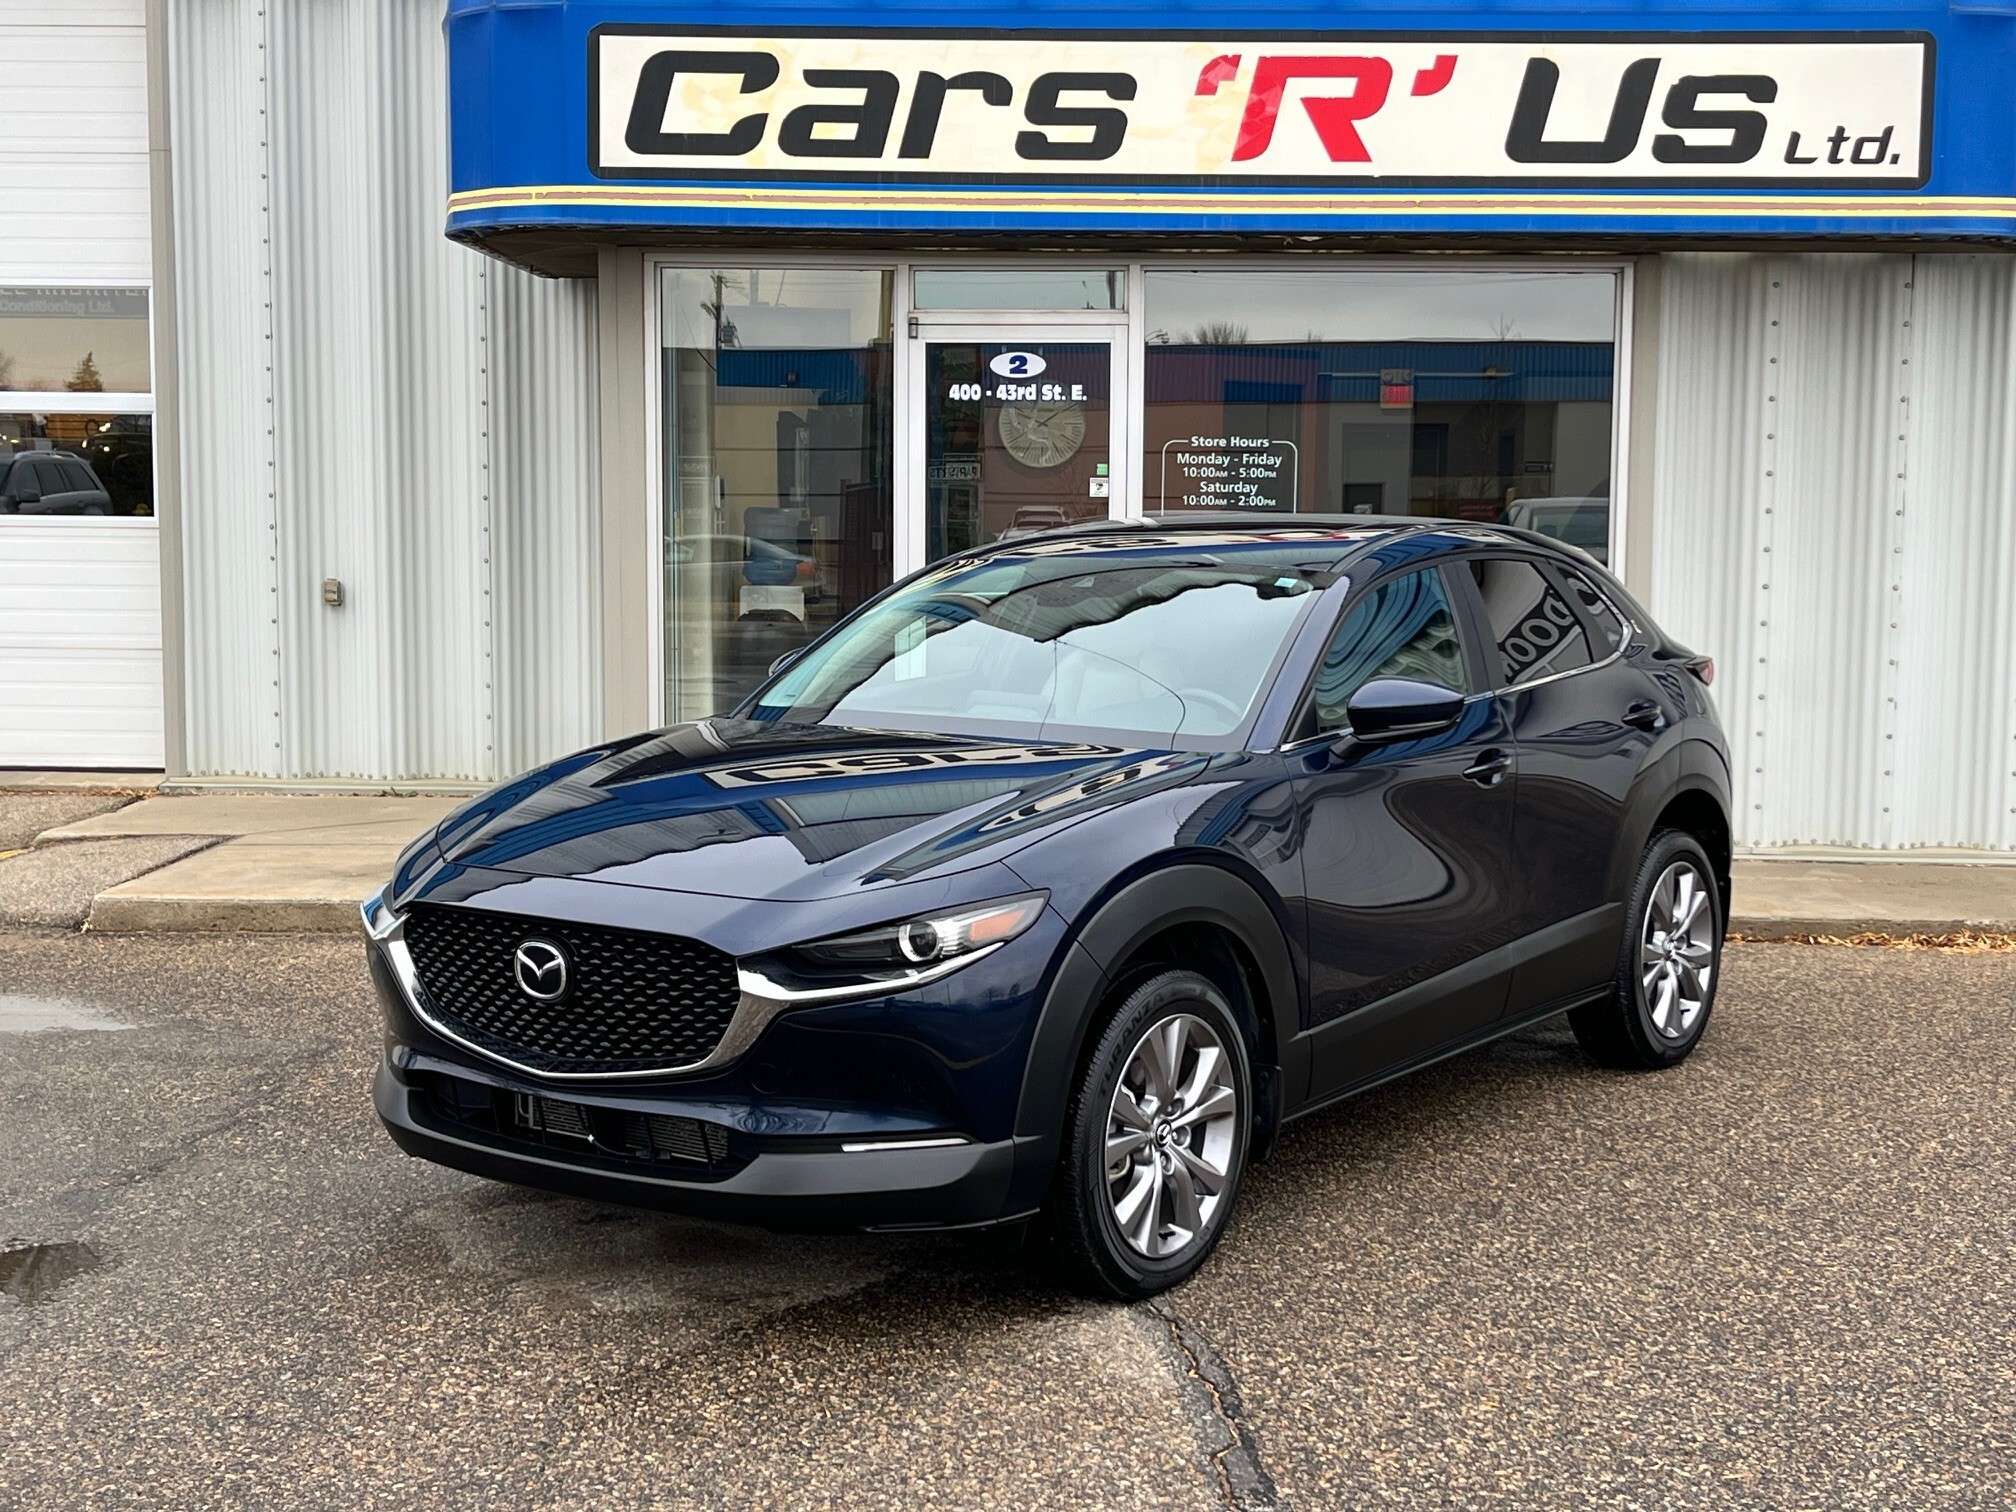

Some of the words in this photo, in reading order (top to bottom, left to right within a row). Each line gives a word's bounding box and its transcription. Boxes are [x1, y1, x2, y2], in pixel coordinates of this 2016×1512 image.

[625, 51, 1137, 160] Cars
[1506, 58, 1777, 163] Us
[1784, 126, 1900, 165] Ltd.
[1009, 355, 1028, 374] 2
[949, 384, 981, 400] 400
[997, 384, 1036, 400] 43rd
[1042, 384, 1066, 400] St.
[1072, 384, 1087, 400] E.
[1191, 436, 1226, 447] Store
[1231, 436, 1269, 447] Hours
[1178, 453, 1230, 467] Monday
[1243, 453, 1282, 466] Friday
[1200, 481, 1258, 495] Saturday
